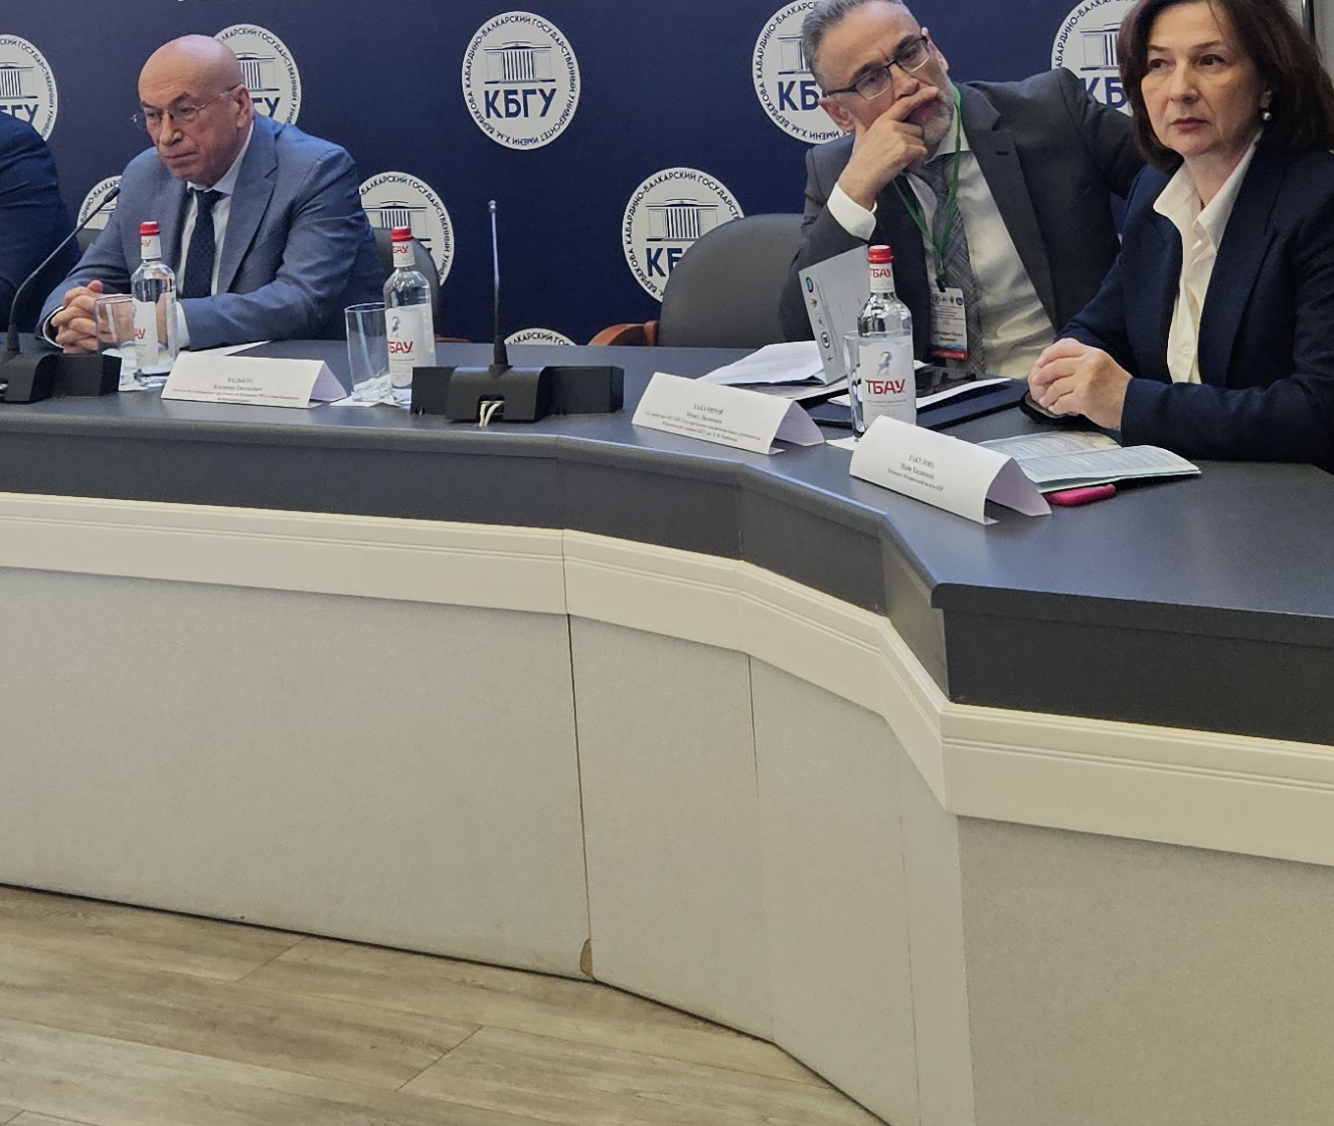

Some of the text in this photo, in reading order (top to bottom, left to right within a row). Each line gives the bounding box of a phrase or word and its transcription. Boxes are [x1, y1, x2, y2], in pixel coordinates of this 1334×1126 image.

[484, 88, 556, 119] КБГУ
[778, 81, 820, 111] КБ
[388, 341, 413, 353] БАУ
[865, 379, 905, 395] ТБАУ
